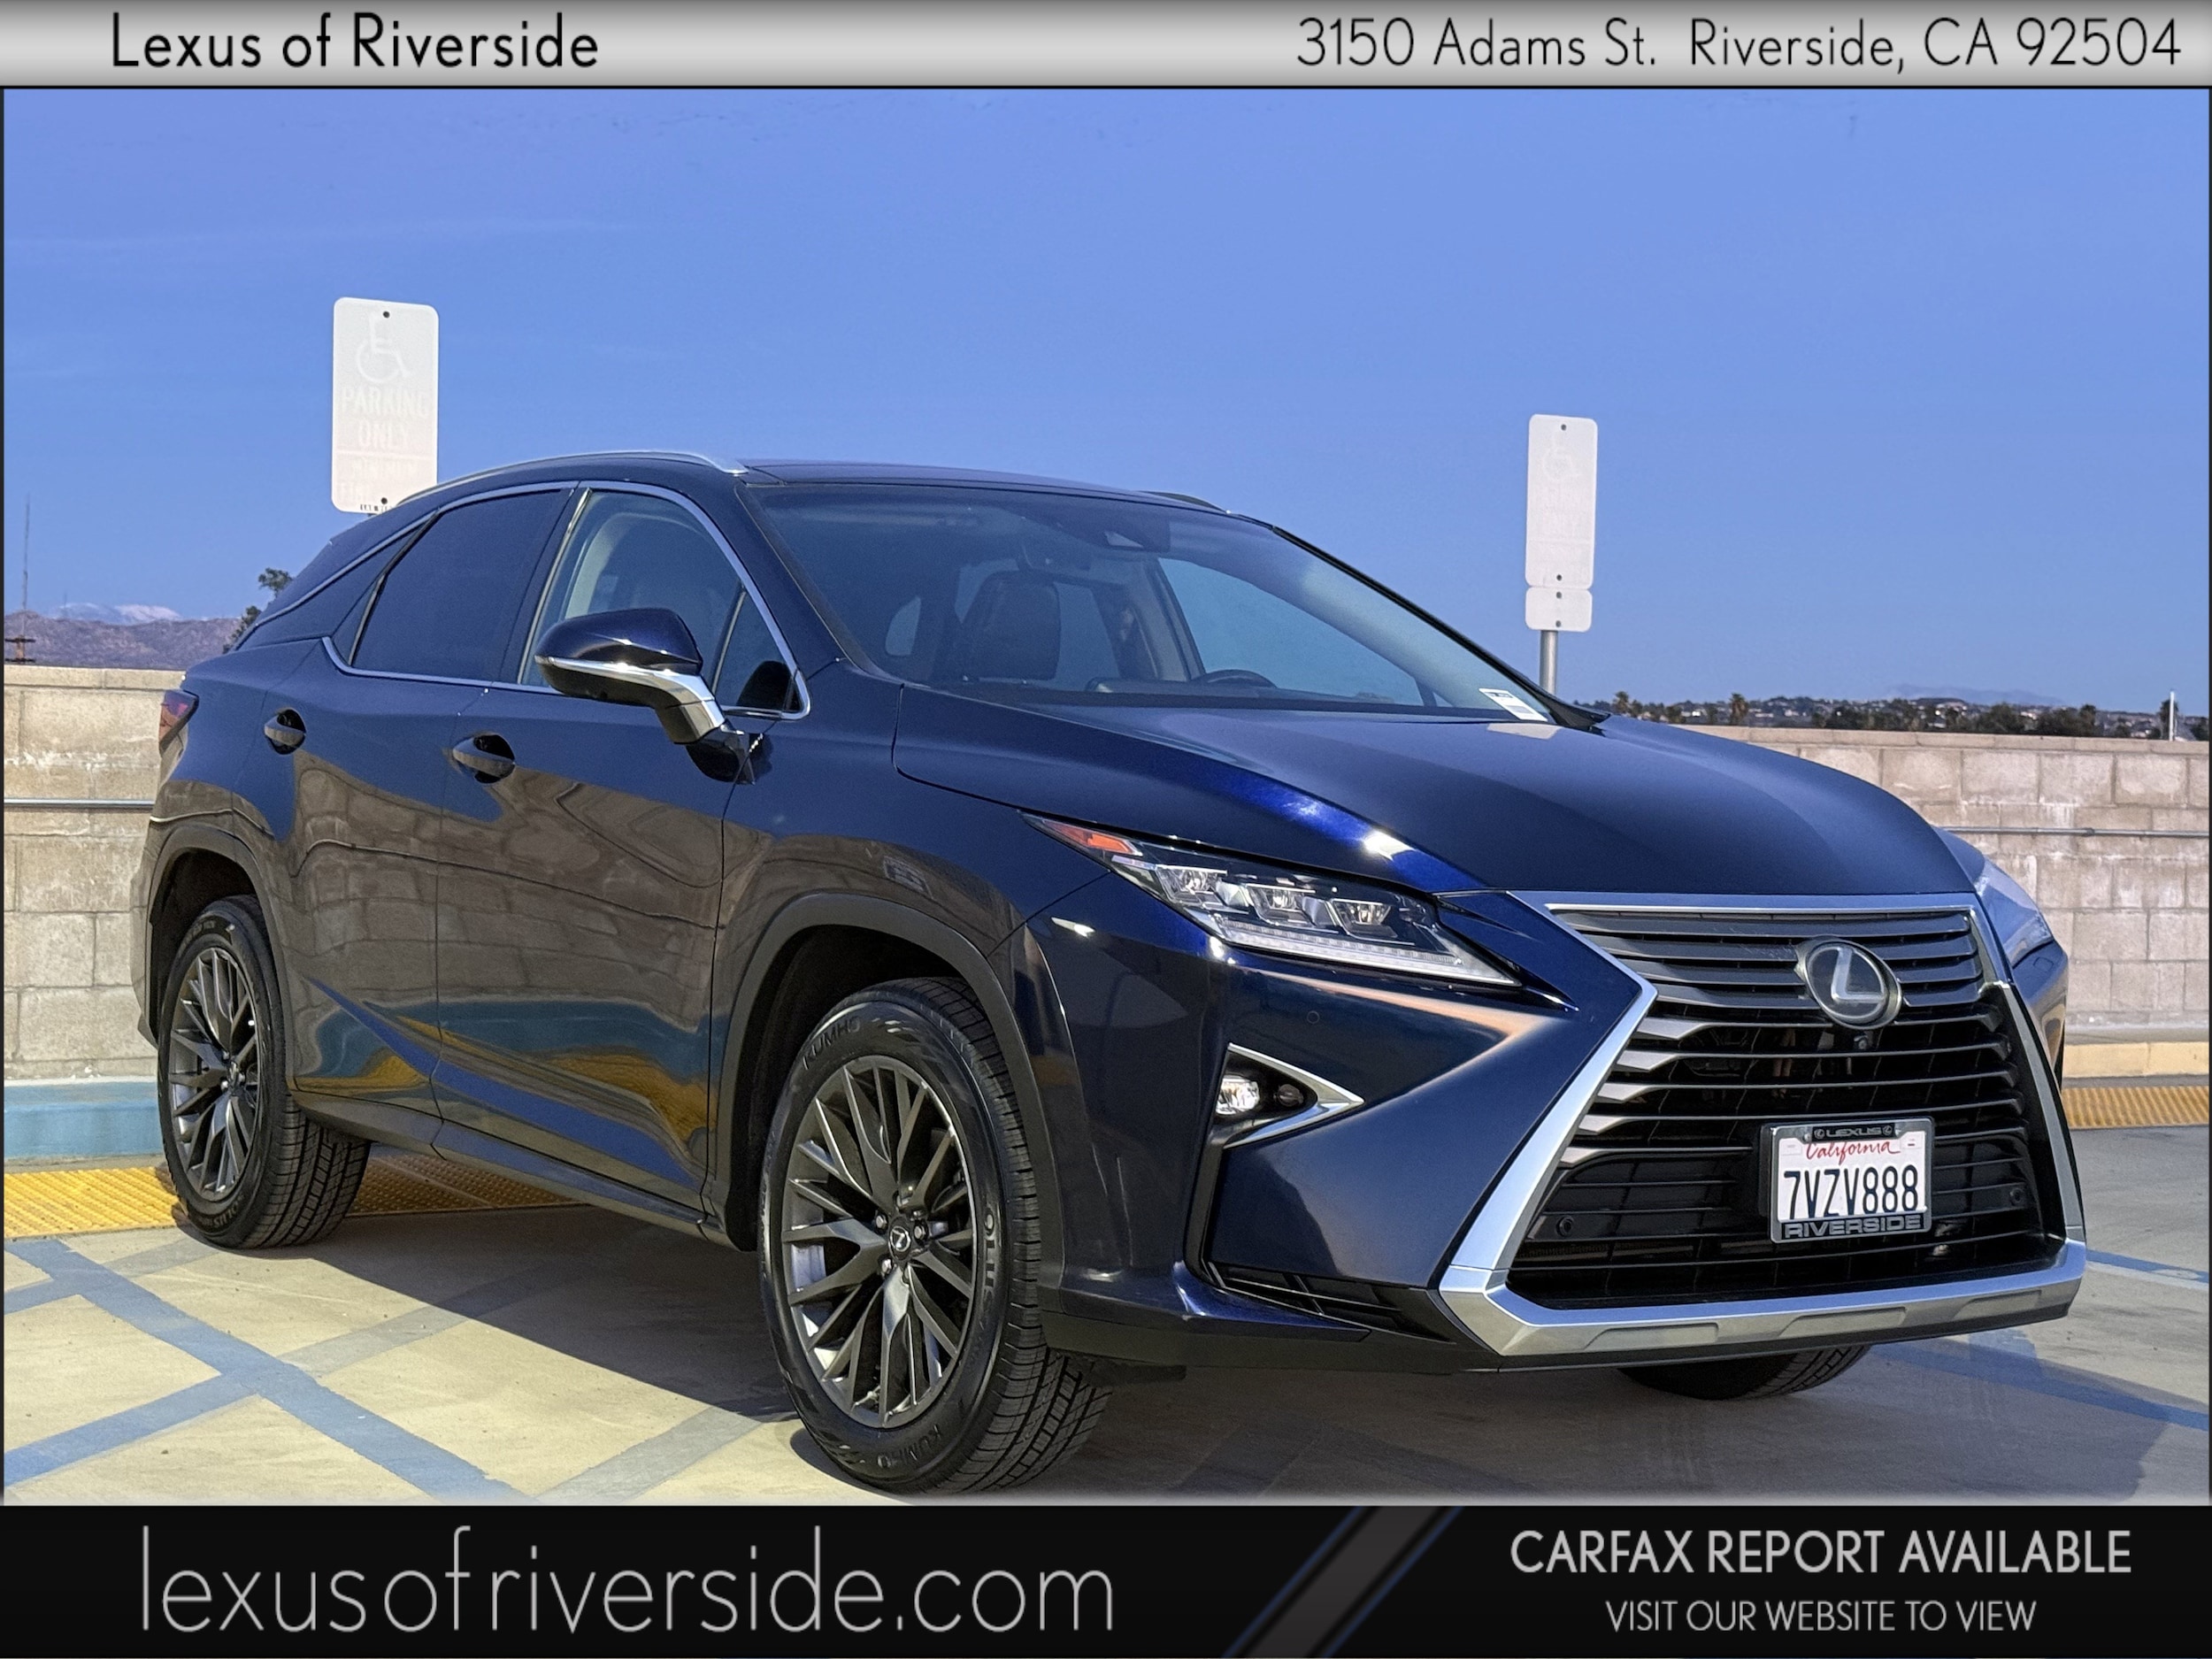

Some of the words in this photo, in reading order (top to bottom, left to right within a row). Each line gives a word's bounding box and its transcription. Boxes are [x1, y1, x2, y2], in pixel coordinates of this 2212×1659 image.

[342, 386, 429, 419] PARKING
[358, 419, 408, 449] ONLY
[803, 1016, 861, 1070] KUMHO
[1825, 1126, 1882, 1138] LEXUS
[1806, 1141, 1901, 1166] California
[1783, 1164, 1918, 1220] 7VZV888
[1784, 1215, 1922, 1239] RIVERSIDE
